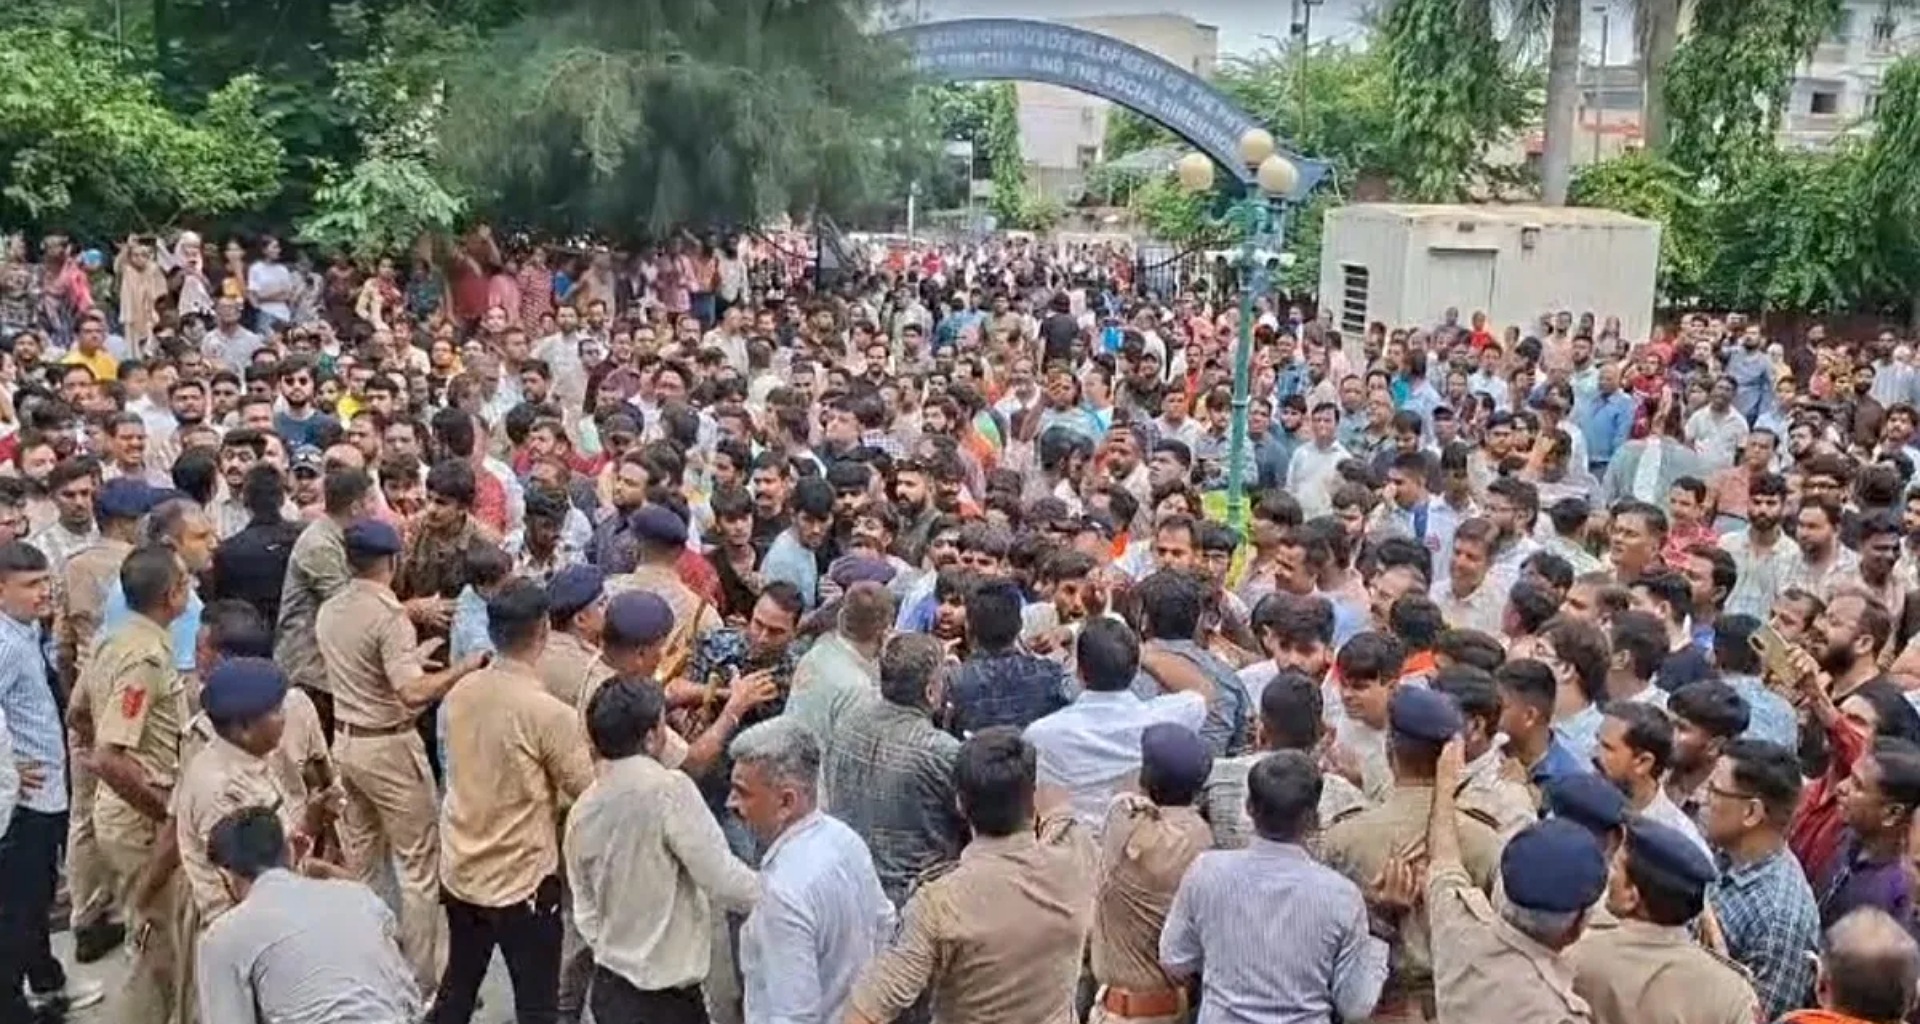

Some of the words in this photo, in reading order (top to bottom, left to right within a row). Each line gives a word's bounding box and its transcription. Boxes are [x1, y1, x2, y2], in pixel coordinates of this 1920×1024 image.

[1030, 54, 1065, 75] AND
[1070, 61, 1101, 84] THE
[1105, 71, 1158, 108] SOCIAL
